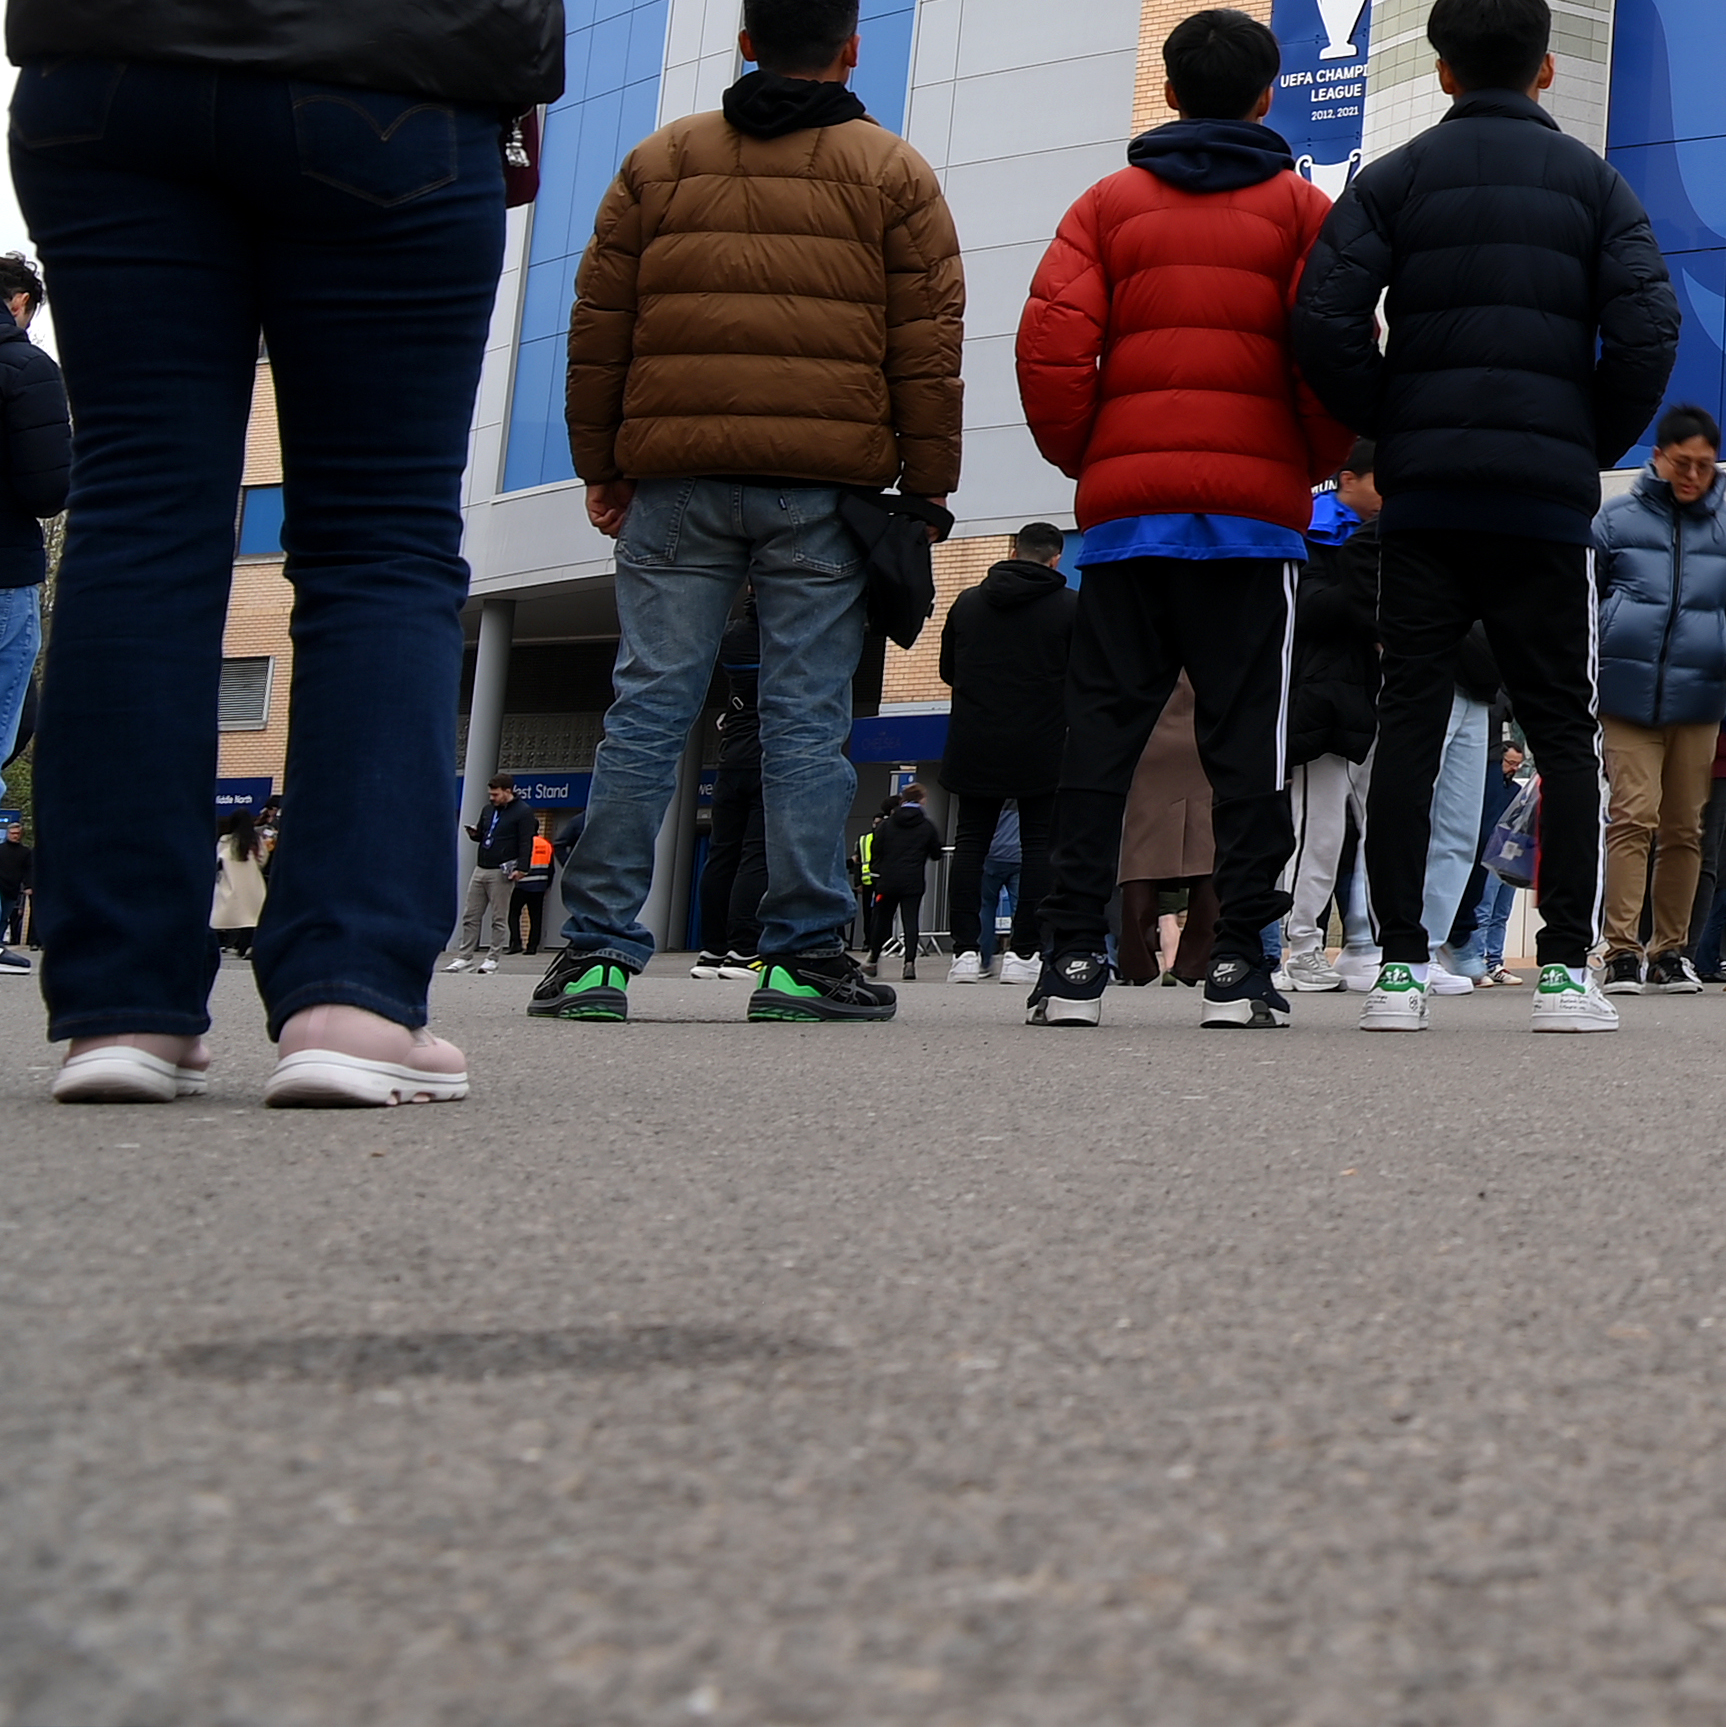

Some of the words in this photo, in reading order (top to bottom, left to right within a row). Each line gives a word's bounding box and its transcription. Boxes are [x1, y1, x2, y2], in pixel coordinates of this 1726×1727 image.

[1280, 71, 1313, 88] UEFA
[1310, 83, 1362, 102] LEAGUE
[1337, 105, 1359, 118] 2021
[535, 782, 569, 799] Stand
